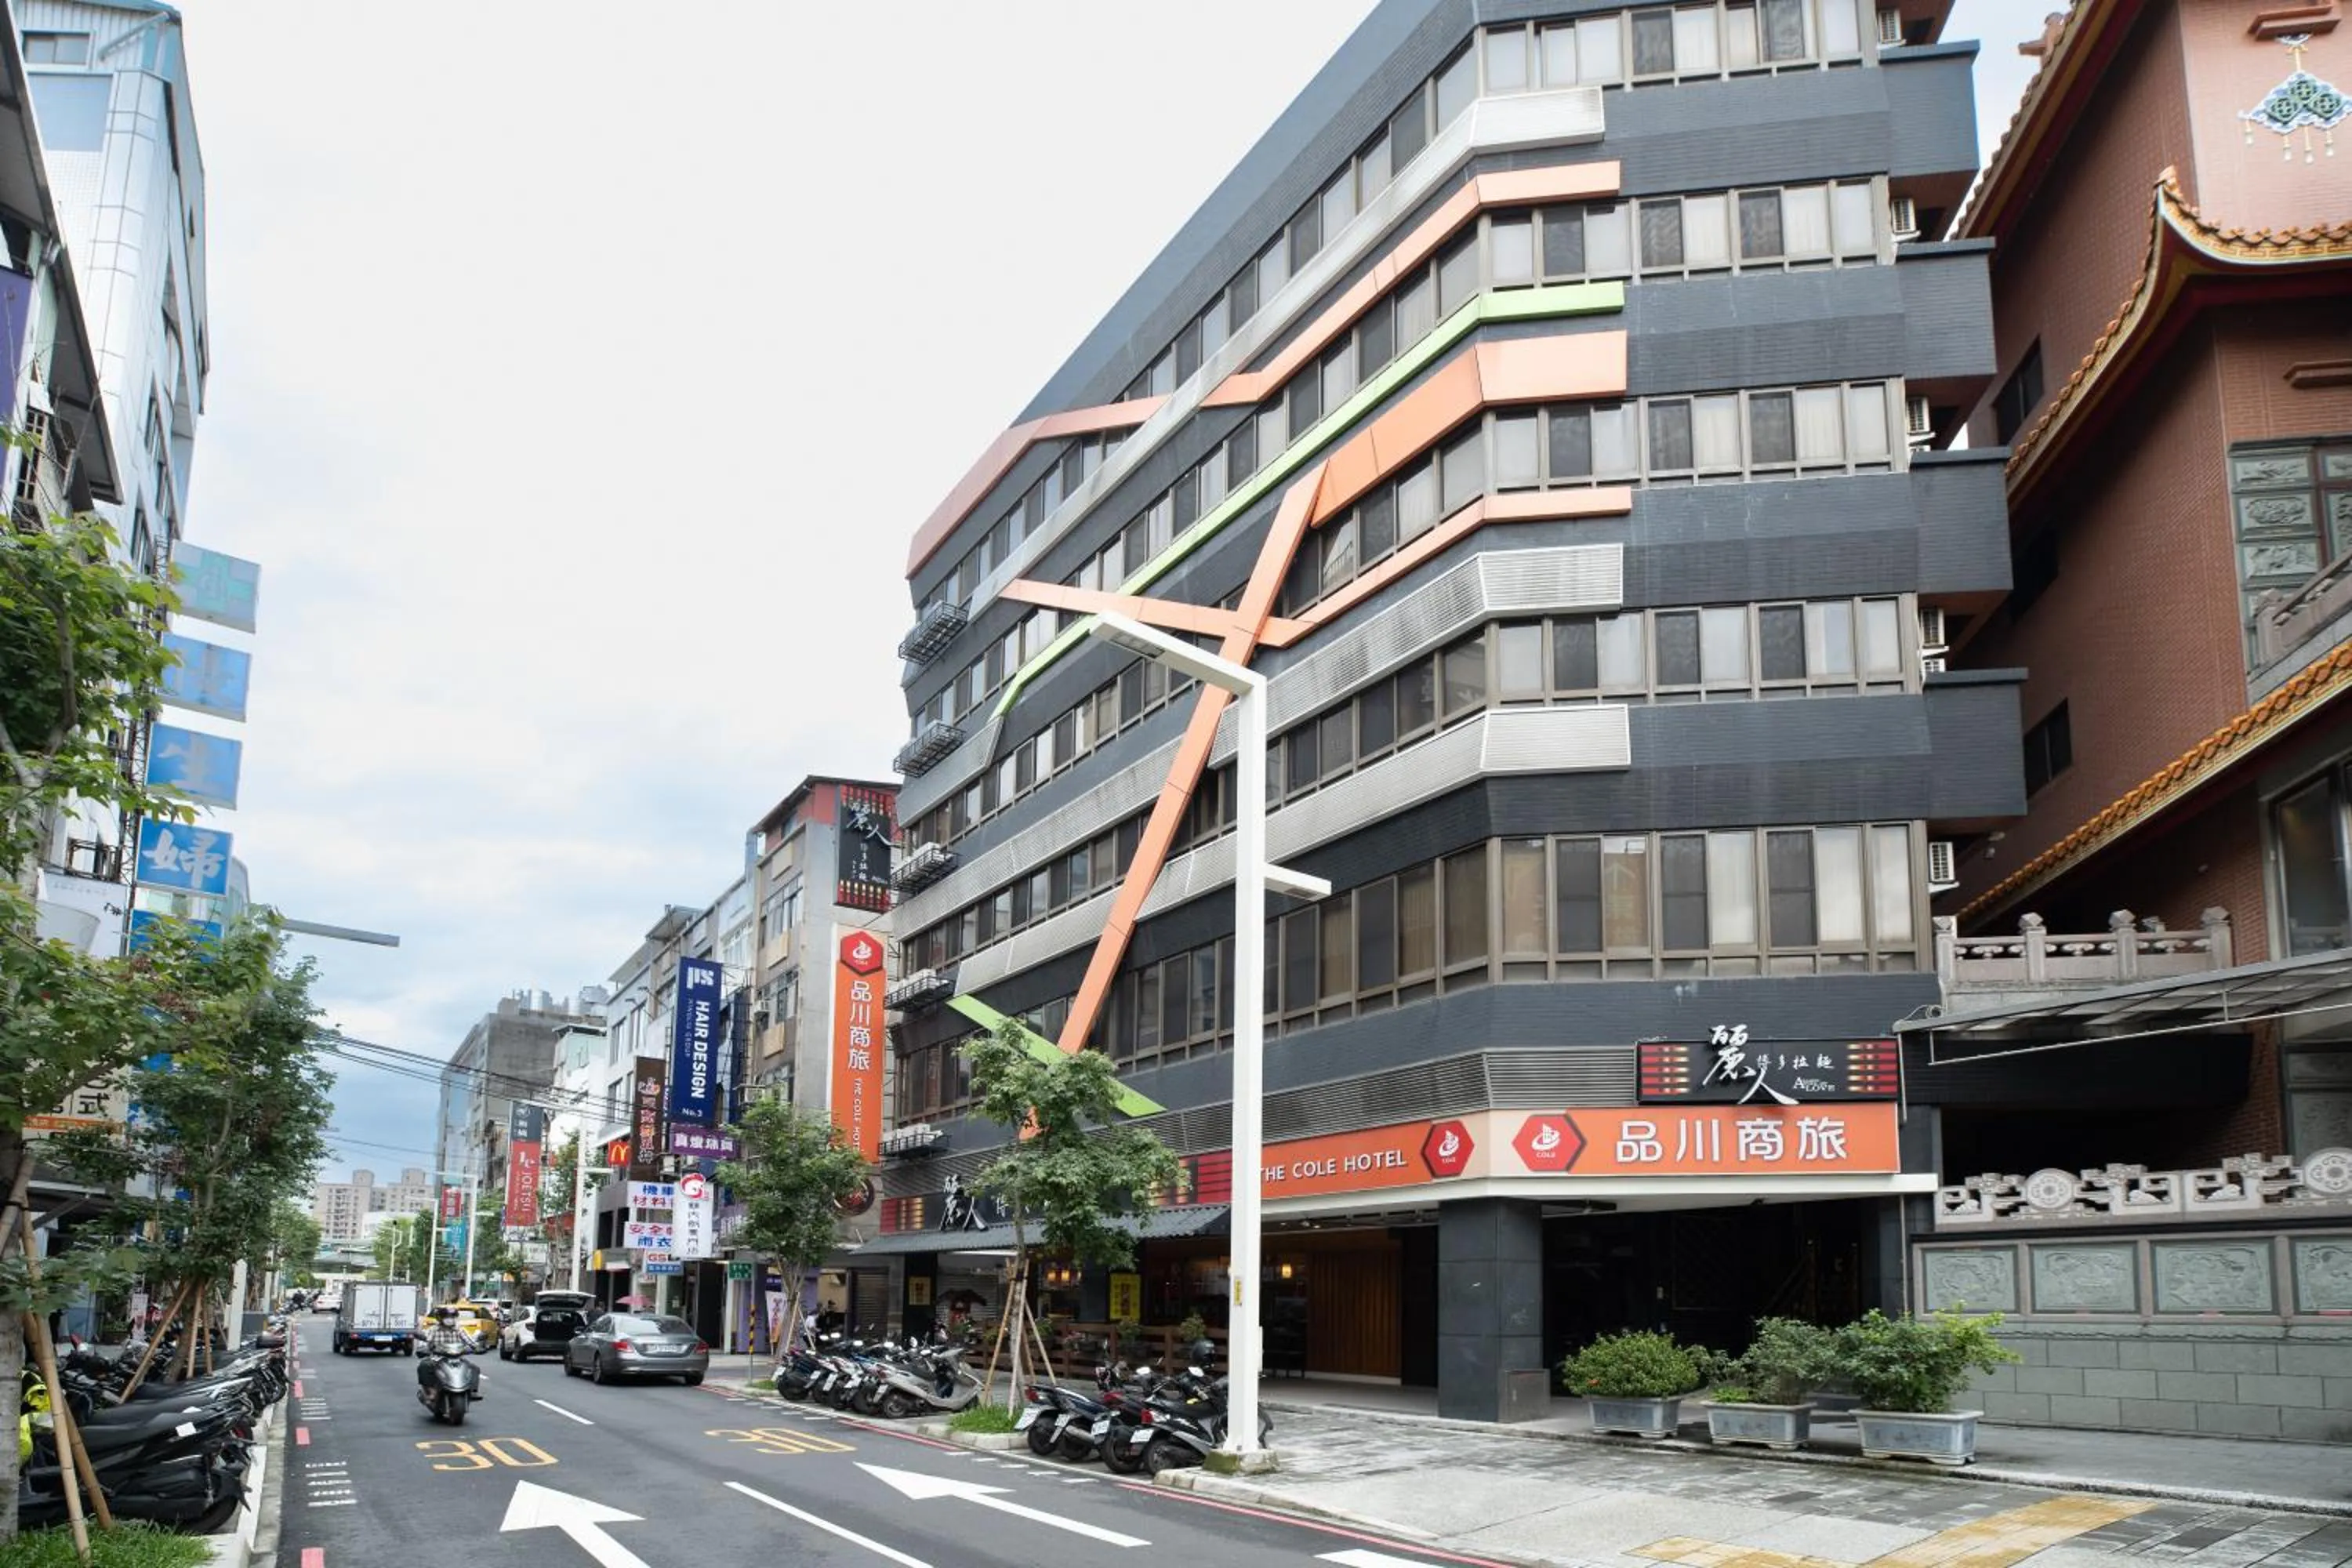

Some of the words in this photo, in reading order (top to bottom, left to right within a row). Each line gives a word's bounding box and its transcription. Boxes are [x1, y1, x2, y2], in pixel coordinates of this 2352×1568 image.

[694, 1000, 711, 1038] HAIR
[848, 980, 873, 1071] 品川商旅
[691, 1043, 710, 1098] DESIGN
[1702, 1023, 1800, 1105] 麗人
[1616, 1116, 1848, 1163] 品川商旅
[1293, 1157, 1337, 1178] COLE
[1344, 1150, 1408, 1173] HOTEL
[633, 1196, 673, 1207] 材料
[416, 1437, 560, 1471] 30
[704, 1428, 858, 1454] 30
